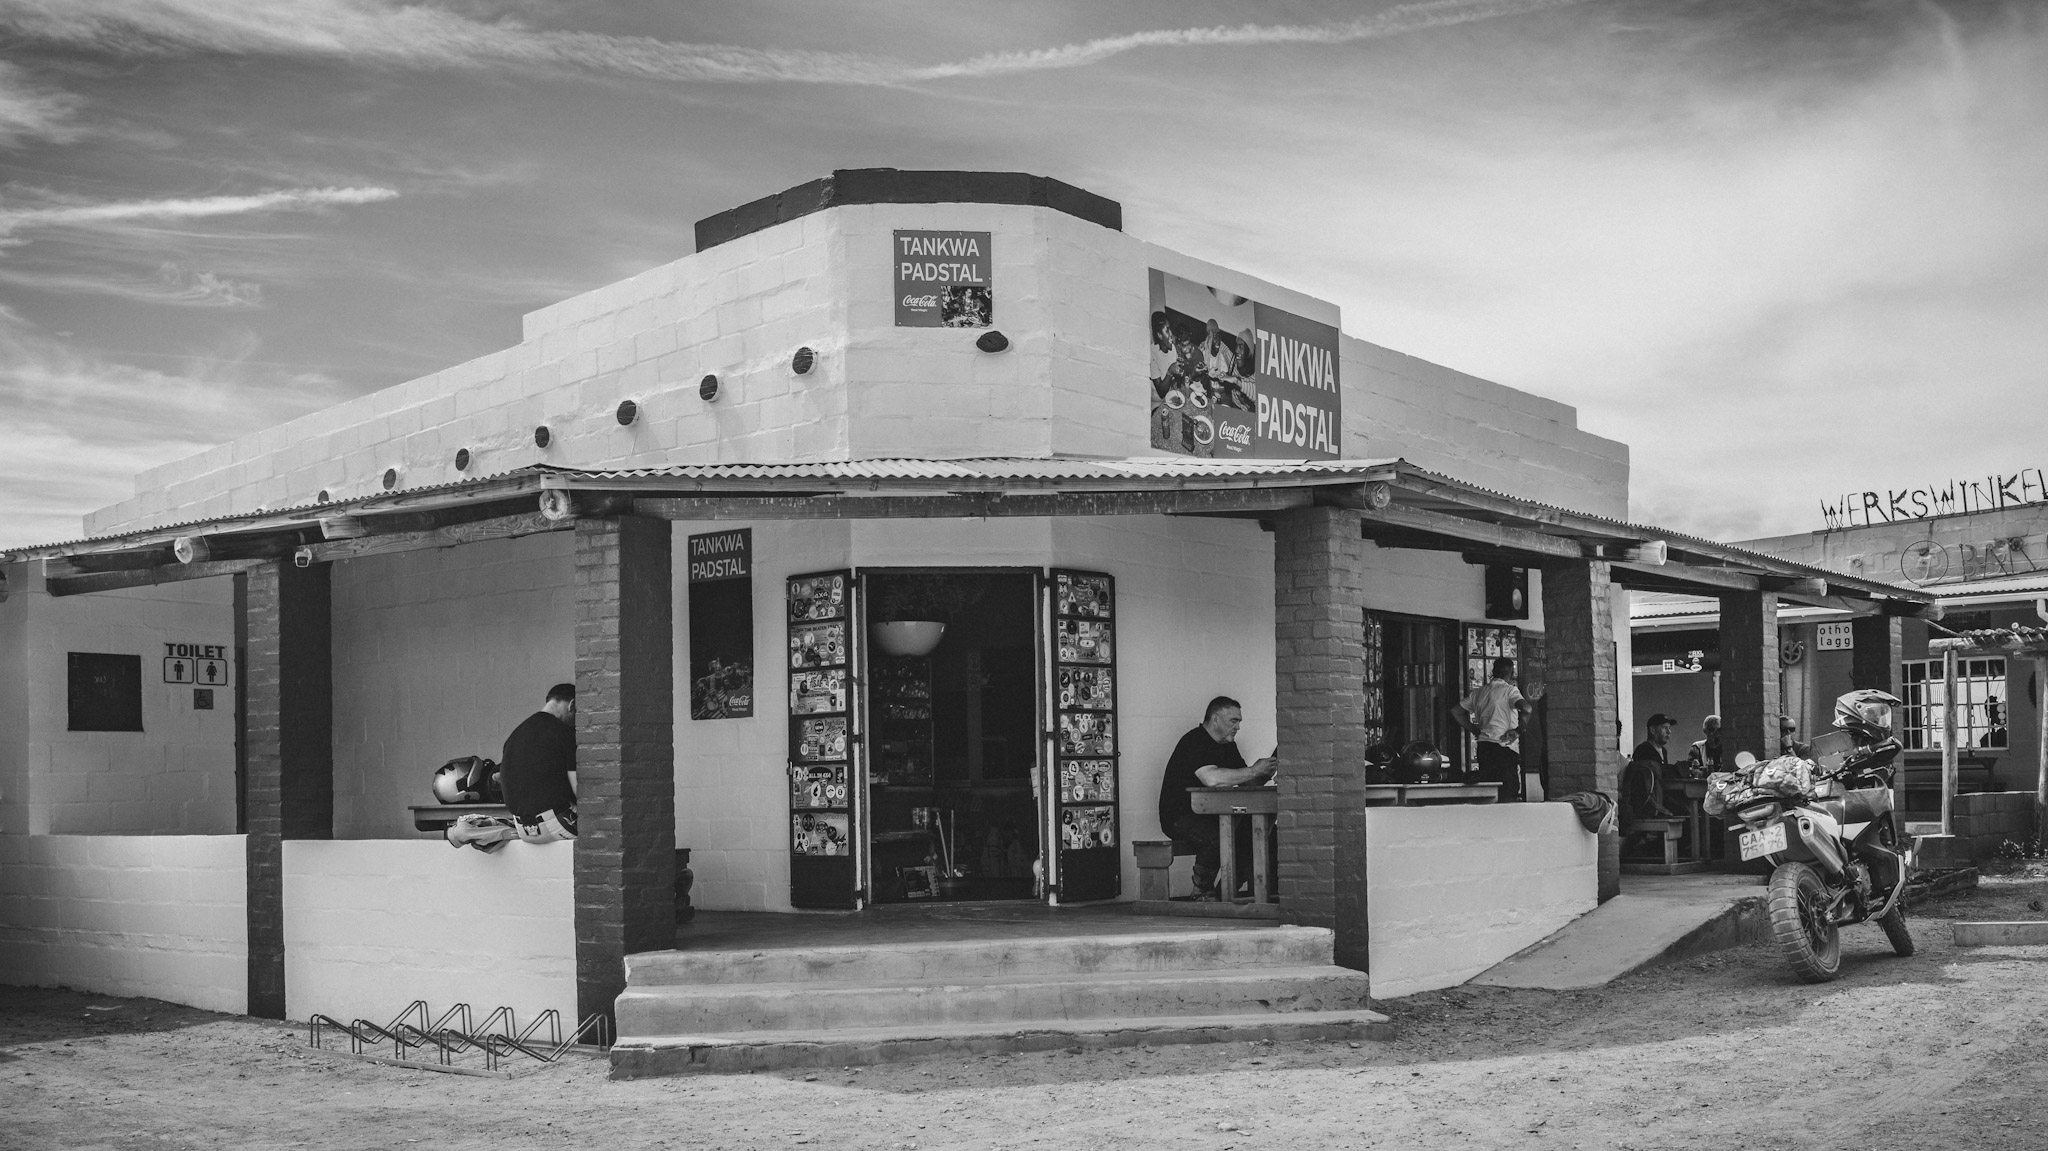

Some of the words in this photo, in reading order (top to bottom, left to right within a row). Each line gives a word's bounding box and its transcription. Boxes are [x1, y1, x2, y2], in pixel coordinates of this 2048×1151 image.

[900, 237, 980, 257] TANKWA
[901, 262, 983, 282] PADSTAL
[1256, 328, 1336, 393] TANKWA
[1257, 393, 1339, 454] PADSTAL
[691, 533, 744, 556] TANKWA
[691, 557, 746, 579] PADSTAL
[165, 643, 226, 658] TOILET
[1820, 636, 1850, 648] lagg
[1741, 831, 1765, 847] CAA
